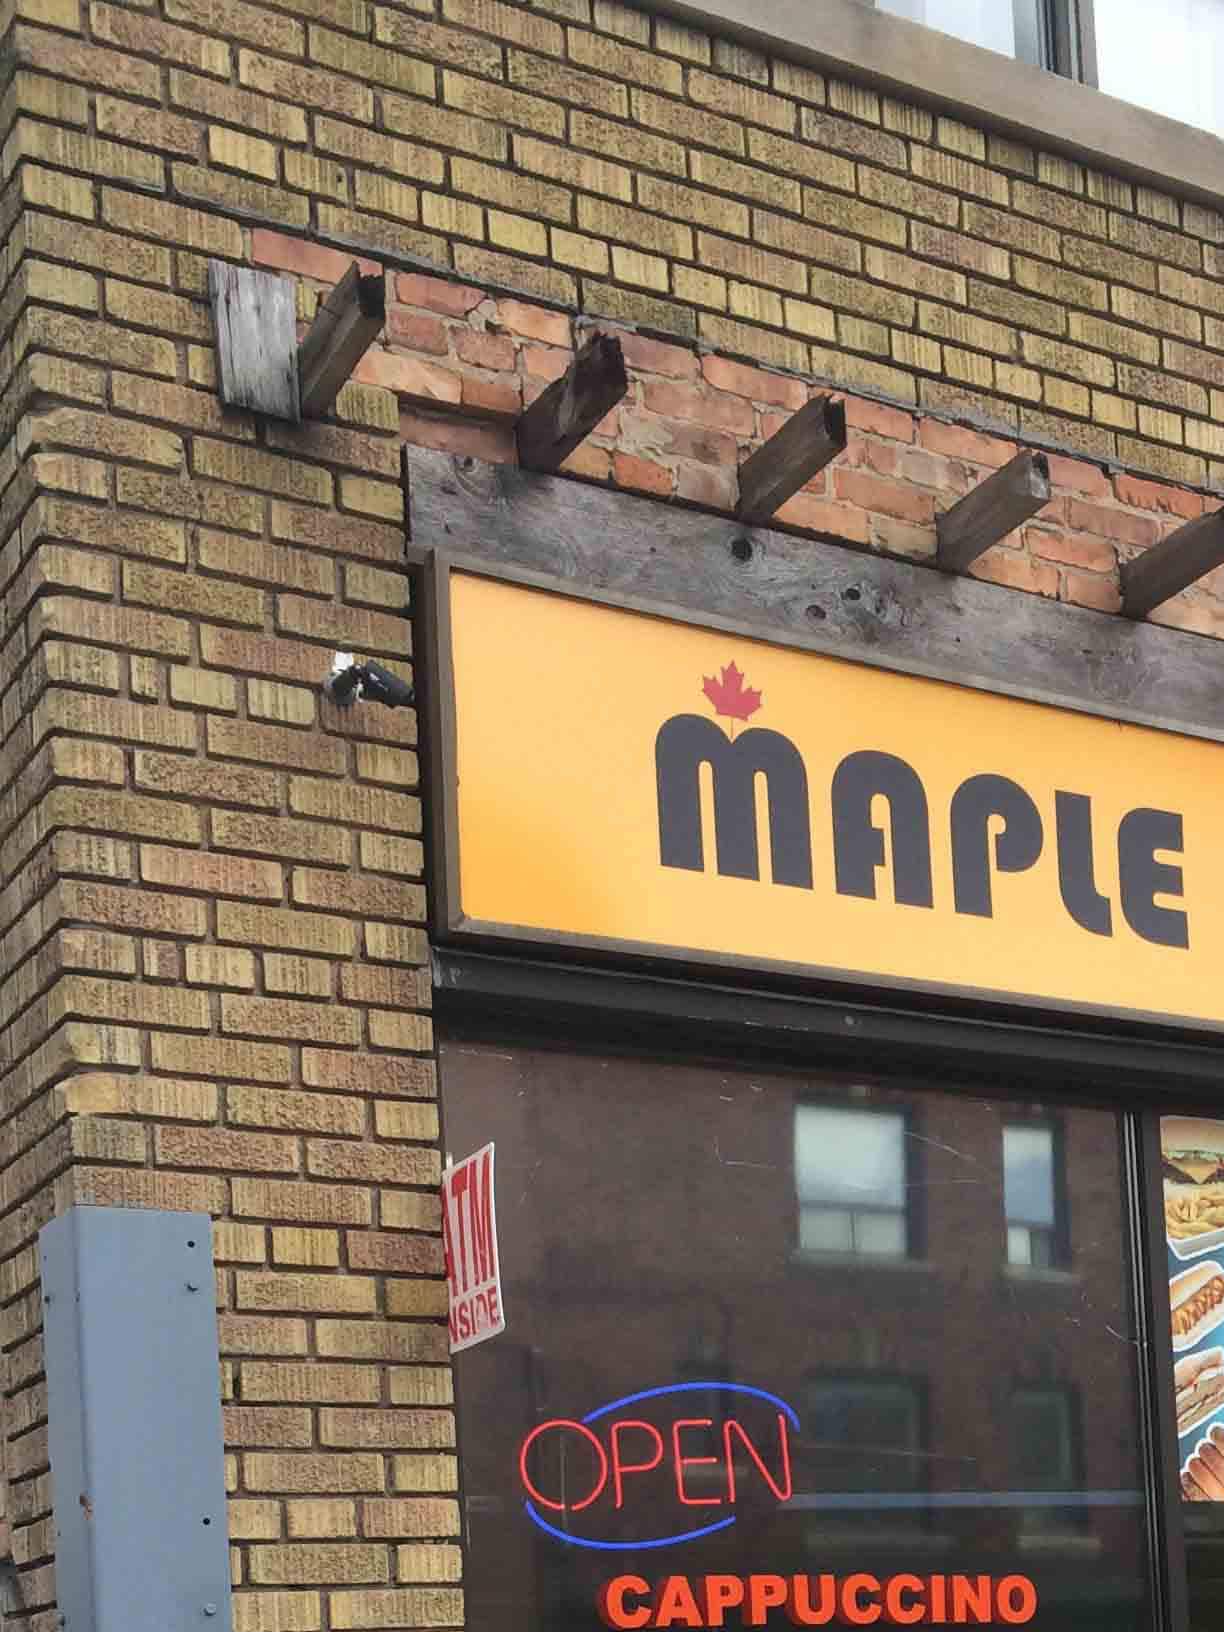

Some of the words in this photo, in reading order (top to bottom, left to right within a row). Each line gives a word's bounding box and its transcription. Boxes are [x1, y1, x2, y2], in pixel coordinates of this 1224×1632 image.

[654, 711, 1190, 950] MAPLE
[447, 1286, 500, 1345] NSIDE
[520, 1414, 794, 1512] OPEN
[604, 1573, 1039, 1630] CAPPUCCINO
